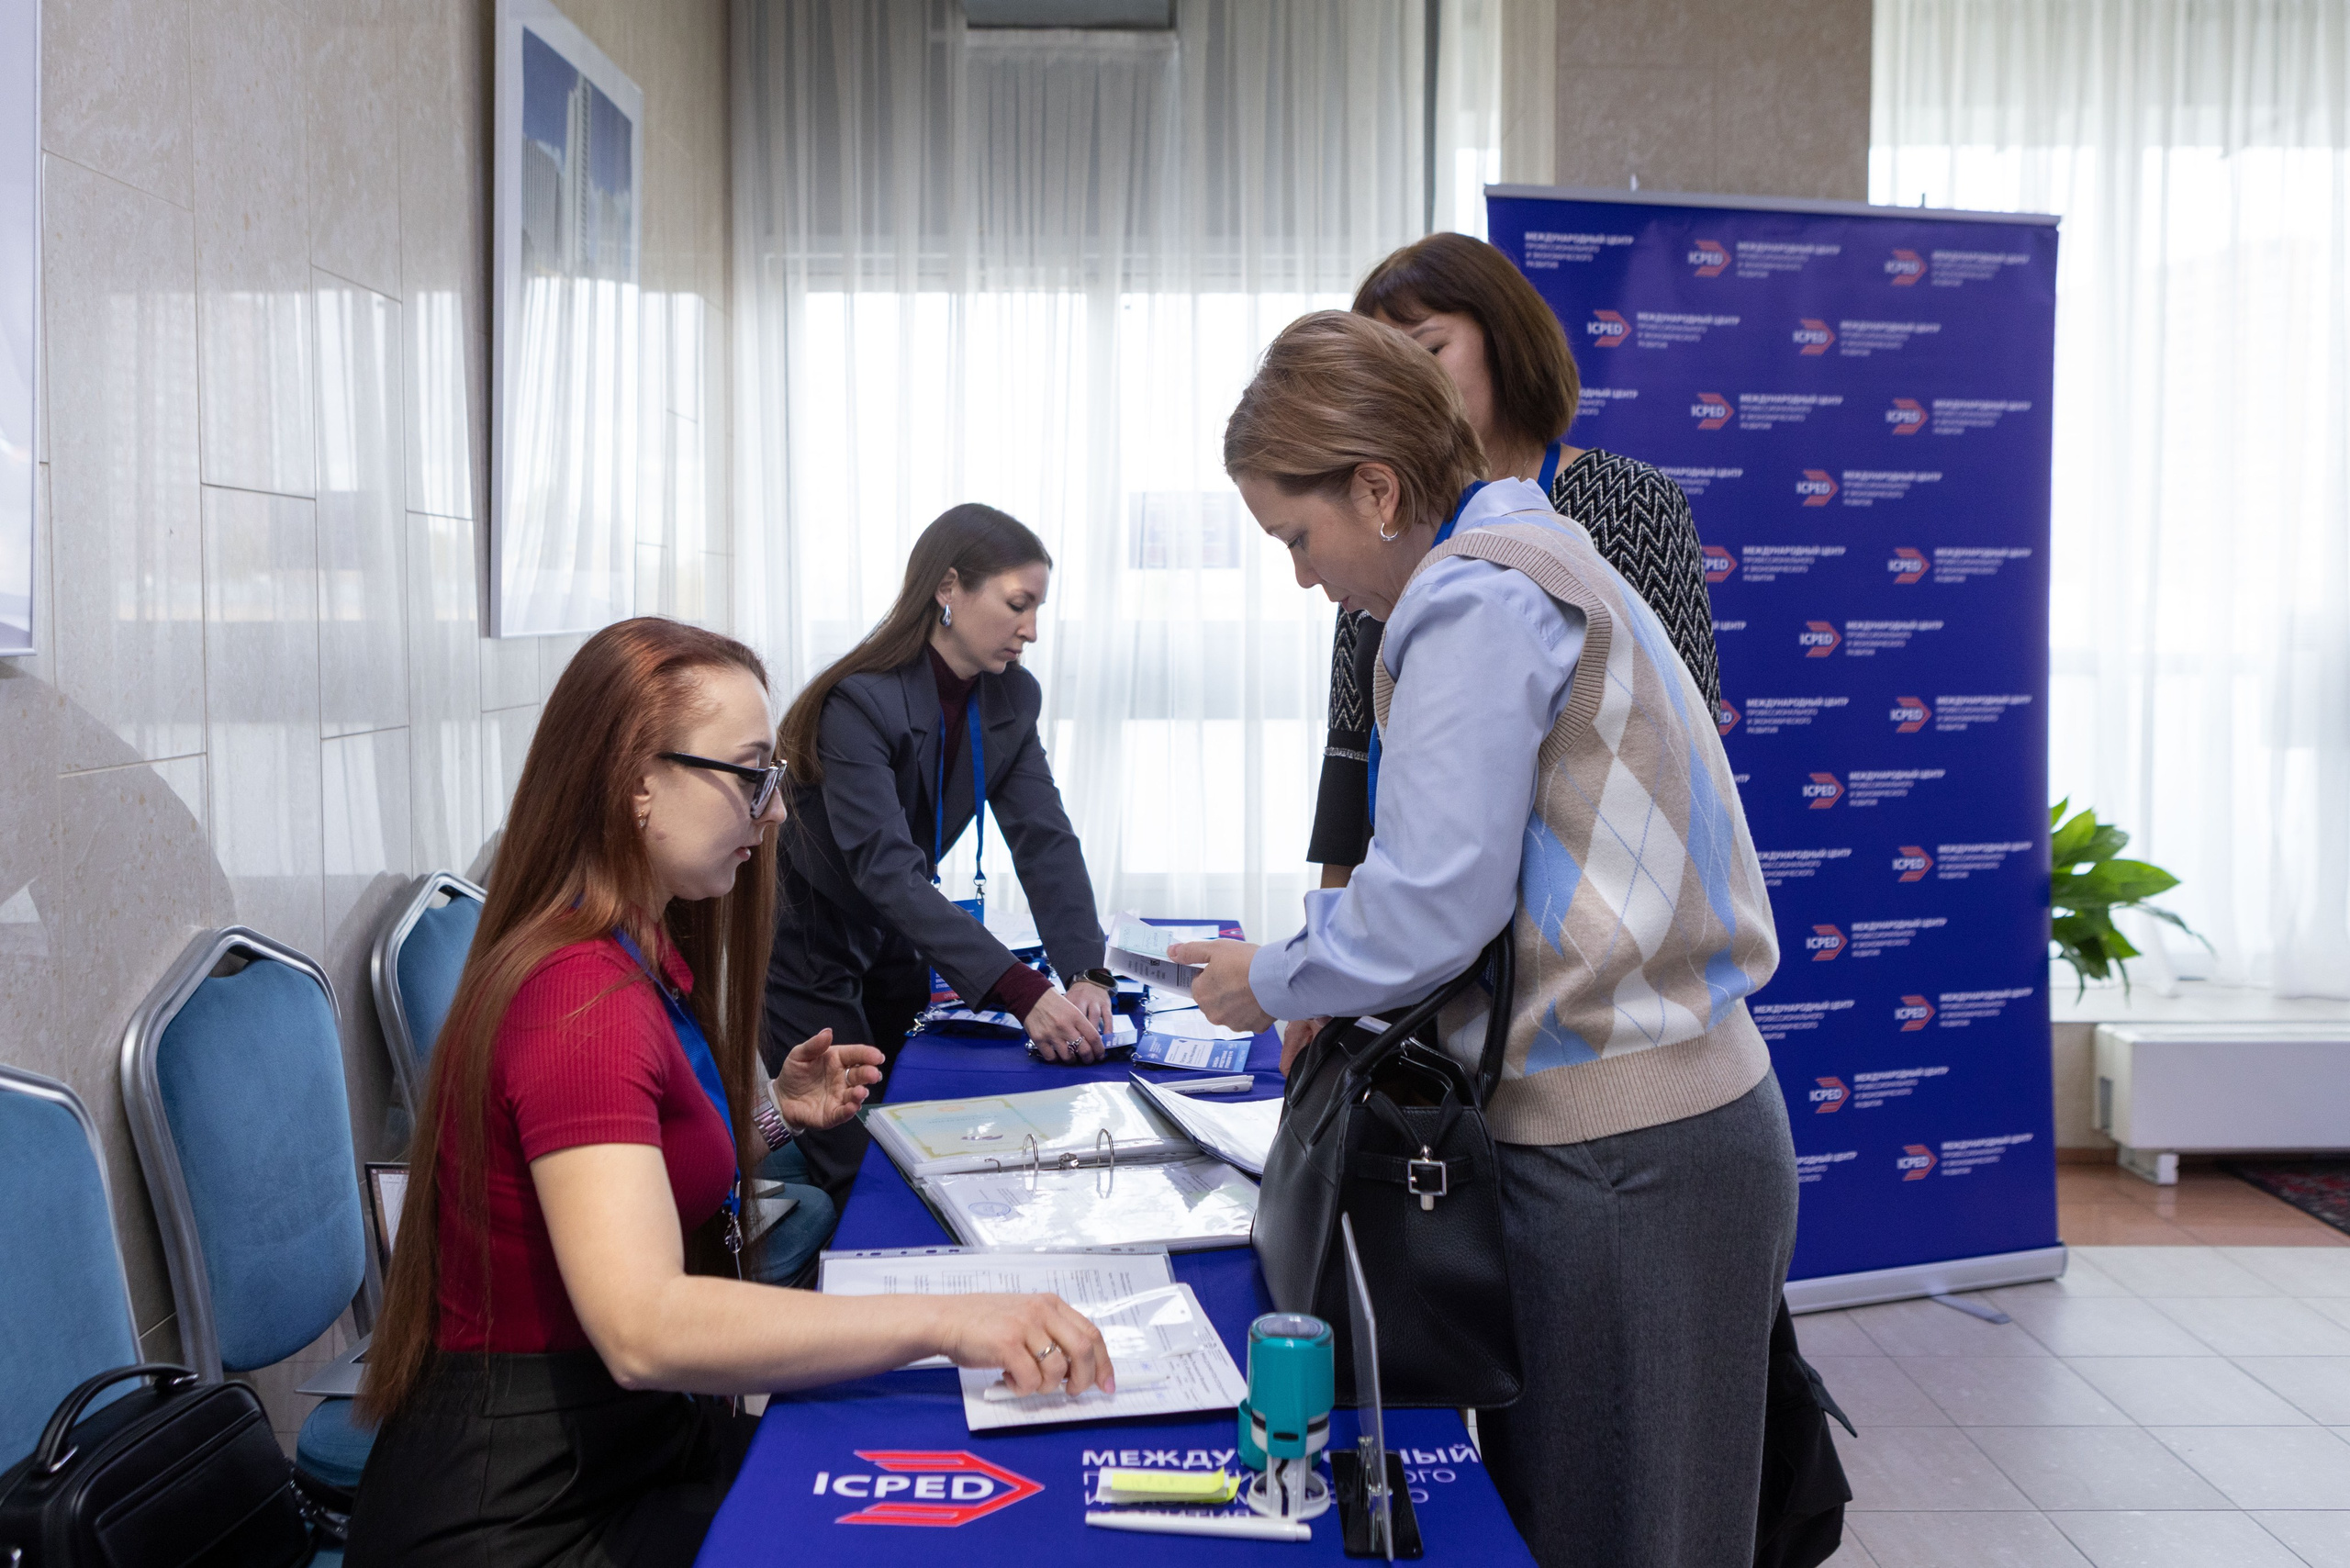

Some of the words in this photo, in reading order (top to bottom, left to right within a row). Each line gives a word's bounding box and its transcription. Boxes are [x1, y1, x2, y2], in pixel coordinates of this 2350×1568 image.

[1688, 252, 1724, 266] ICPED
[1587, 322, 1625, 337] ICPED
[1793, 330, 1829, 344] ICPED
[1691, 405, 1727, 419] ICPED
[1886, 409, 1921, 424] ICPED
[1796, 481, 1831, 495] ICPED
[1888, 559, 1923, 573] ICPED
[1800, 633, 1834, 646] ICPED
[1890, 708, 1924, 722] ICPED
[1803, 784, 1838, 798] ICPED
[1893, 857, 1926, 870] ICPED
[1807, 936, 1841, 949] ICPED
[1896, 1006, 1929, 1020] ICPED
[1810, 1088, 1843, 1102] ICPED
[1082, 1444, 1480, 1469] МЕЖДУЫЙ
[813, 1472, 994, 1500] ICPED
